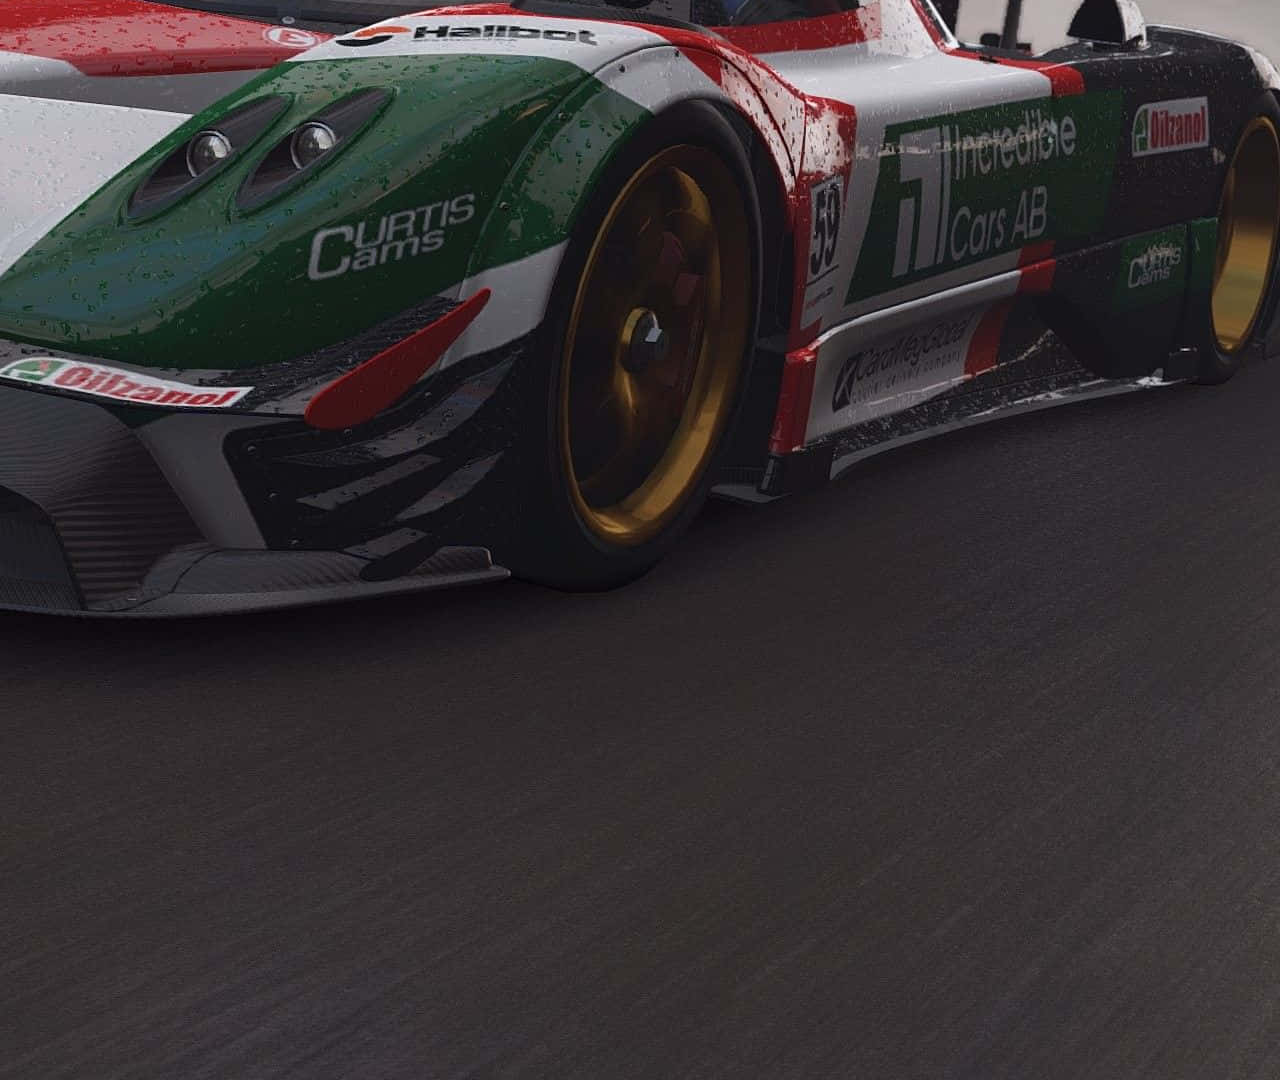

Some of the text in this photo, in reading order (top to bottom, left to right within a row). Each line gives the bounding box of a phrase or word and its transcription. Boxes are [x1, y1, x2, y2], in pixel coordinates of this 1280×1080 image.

[954, 108, 1077, 181] Incredible
[307, 193, 475, 281] CURTIS
[950, 184, 1048, 261] Cars AB
[53, 366, 240, 407] Oilzanol
